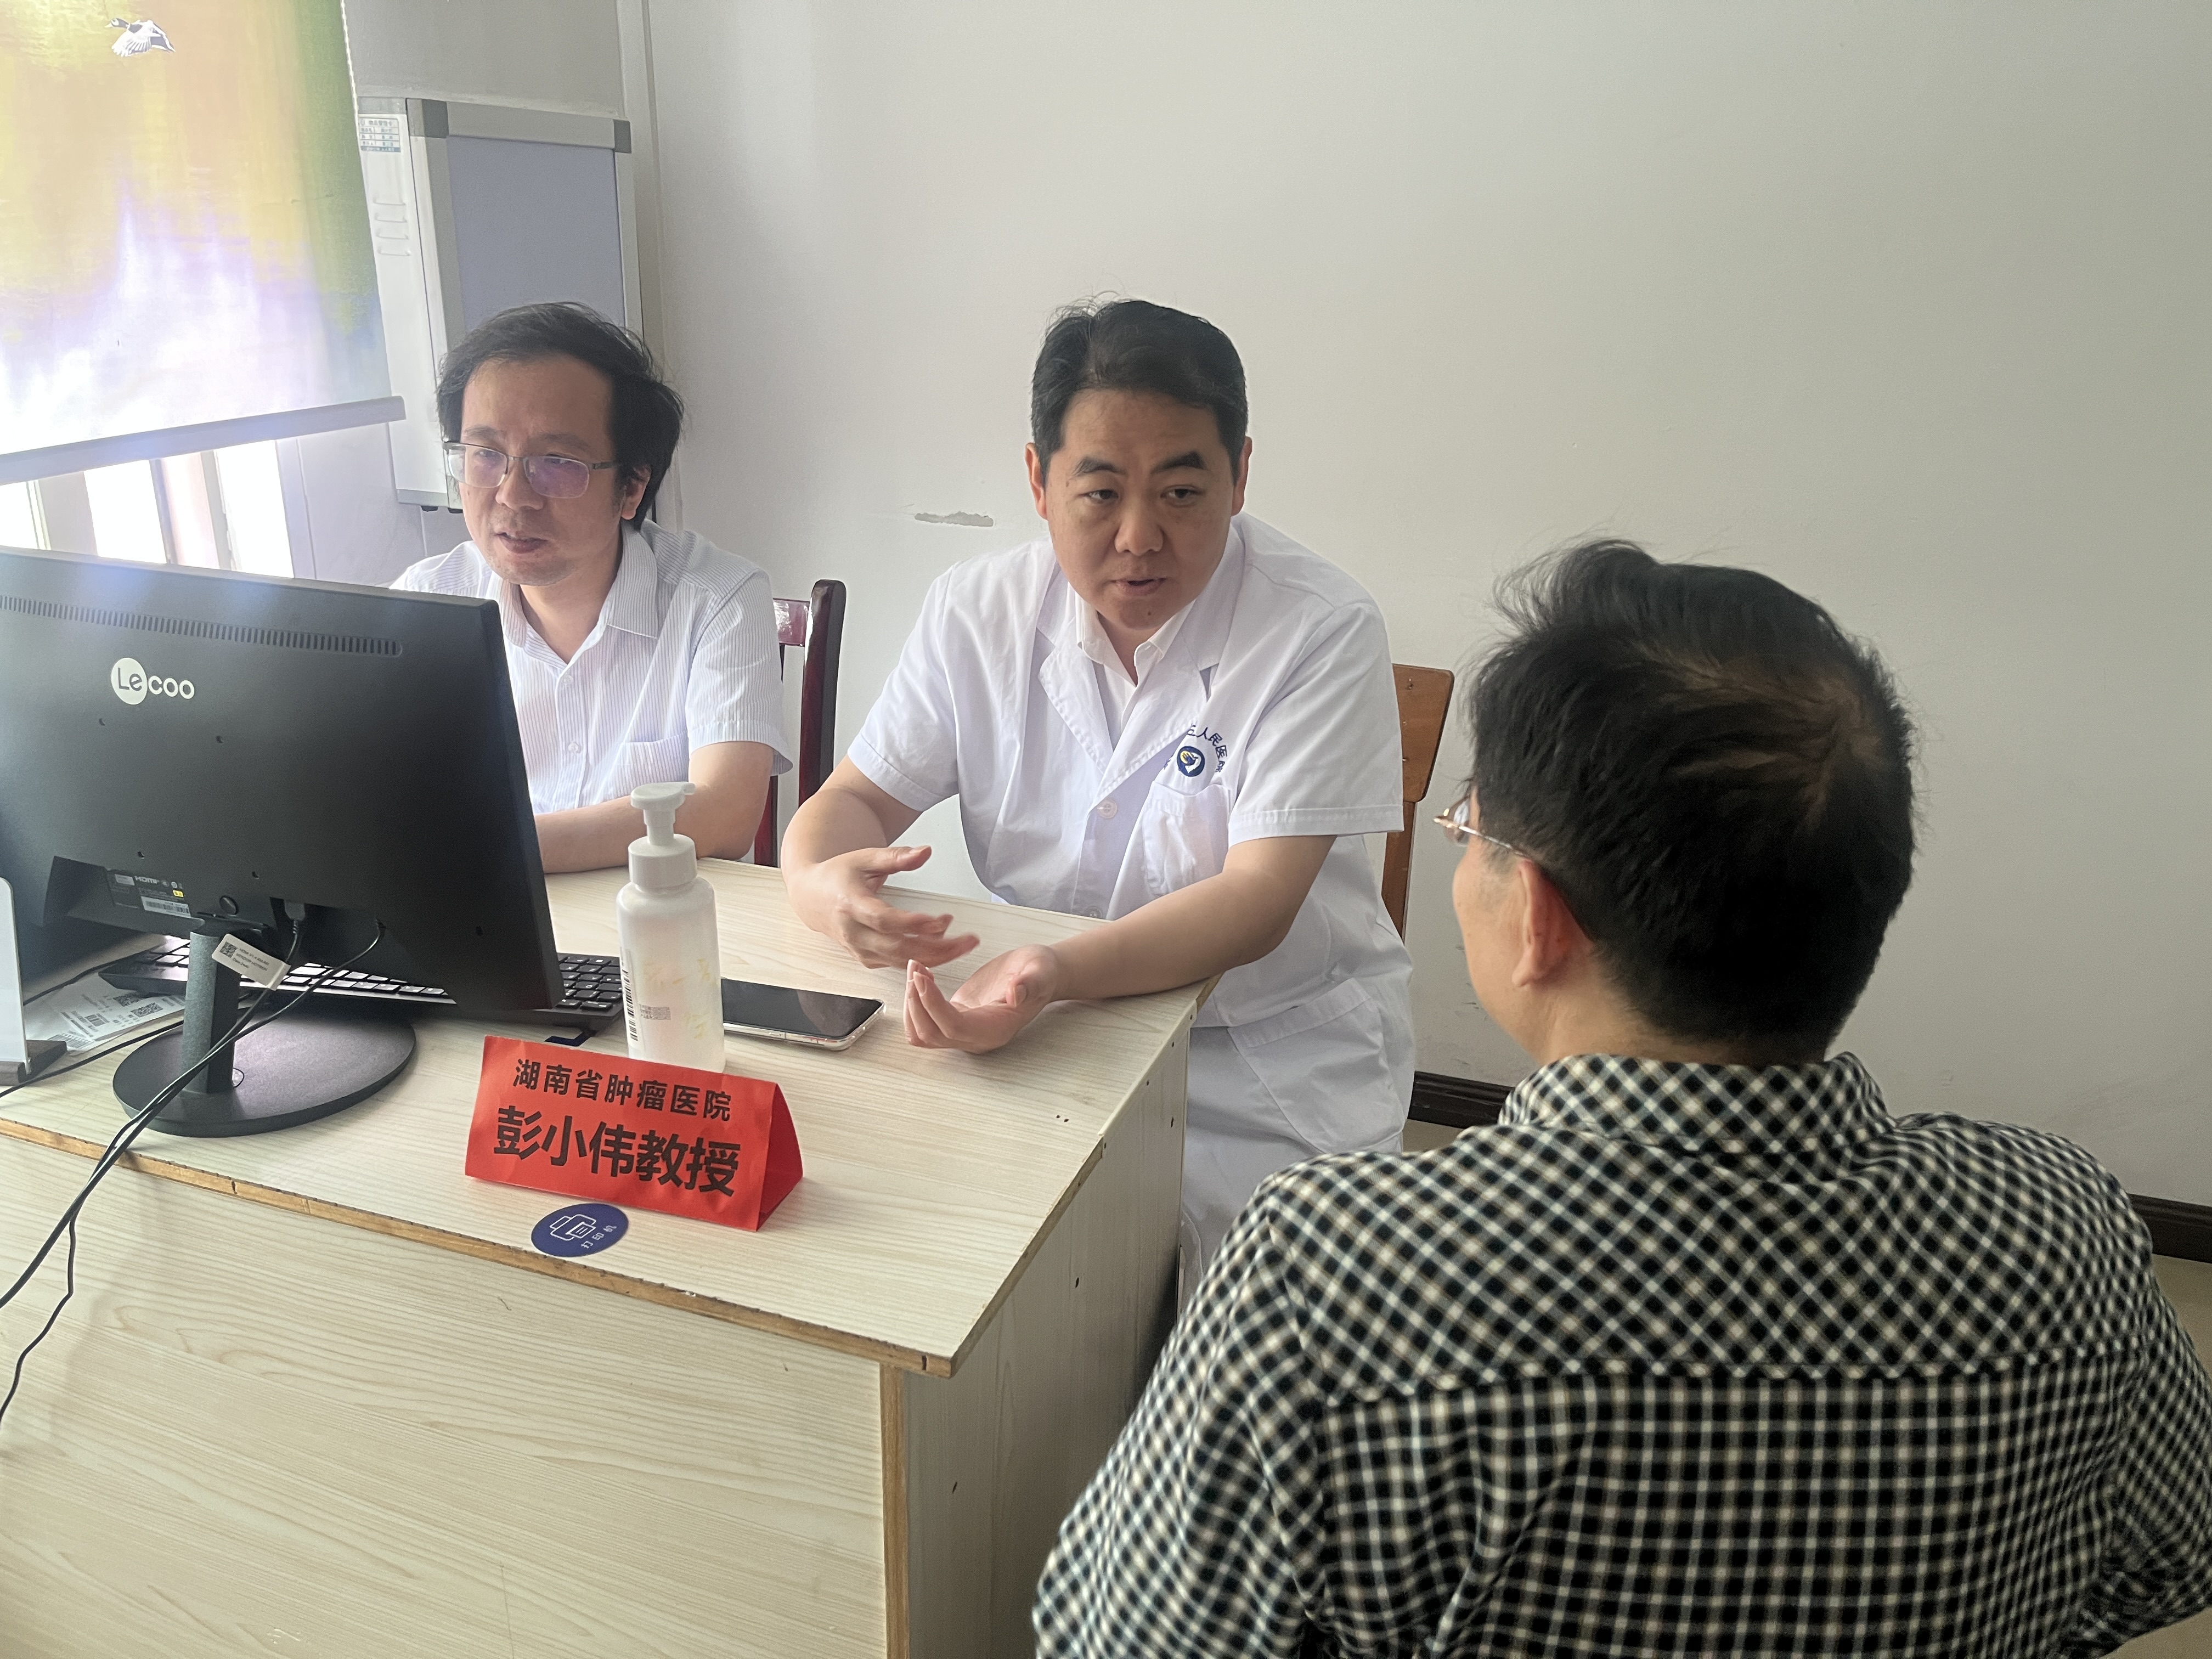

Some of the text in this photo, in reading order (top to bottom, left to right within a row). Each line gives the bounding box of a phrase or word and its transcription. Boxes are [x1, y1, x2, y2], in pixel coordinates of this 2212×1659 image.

[117, 666, 195, 699] Lecoo
[513, 1059, 731, 1121] 湖南省肿瘤医院
[494, 1105, 741, 1197] 彭小伟教授
[581, 1225, 617, 1249] 打印机
